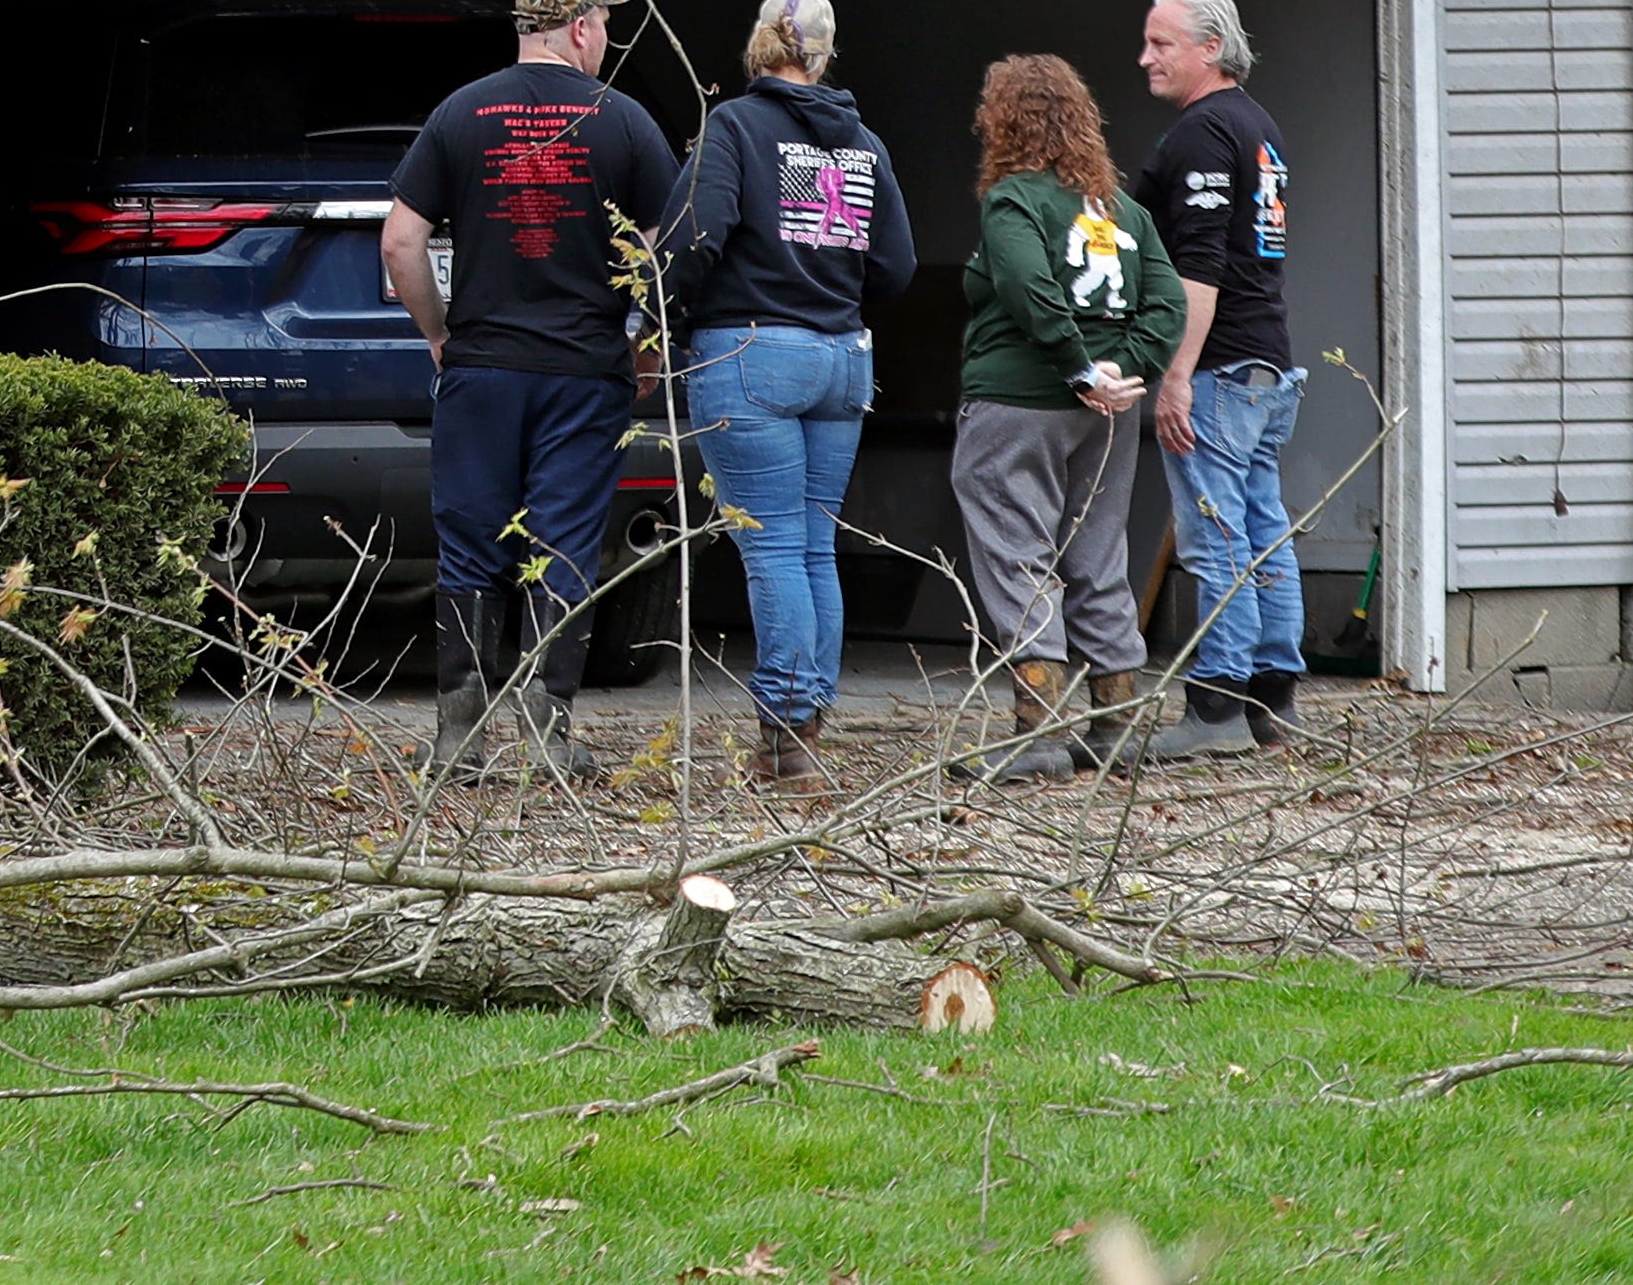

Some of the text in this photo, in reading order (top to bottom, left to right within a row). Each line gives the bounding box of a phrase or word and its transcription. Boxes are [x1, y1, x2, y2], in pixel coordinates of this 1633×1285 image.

[833, 148, 878, 165] COUNTY
[838, 159, 873, 176] OFFICE
[170, 376, 267, 389] TRAVERSE
